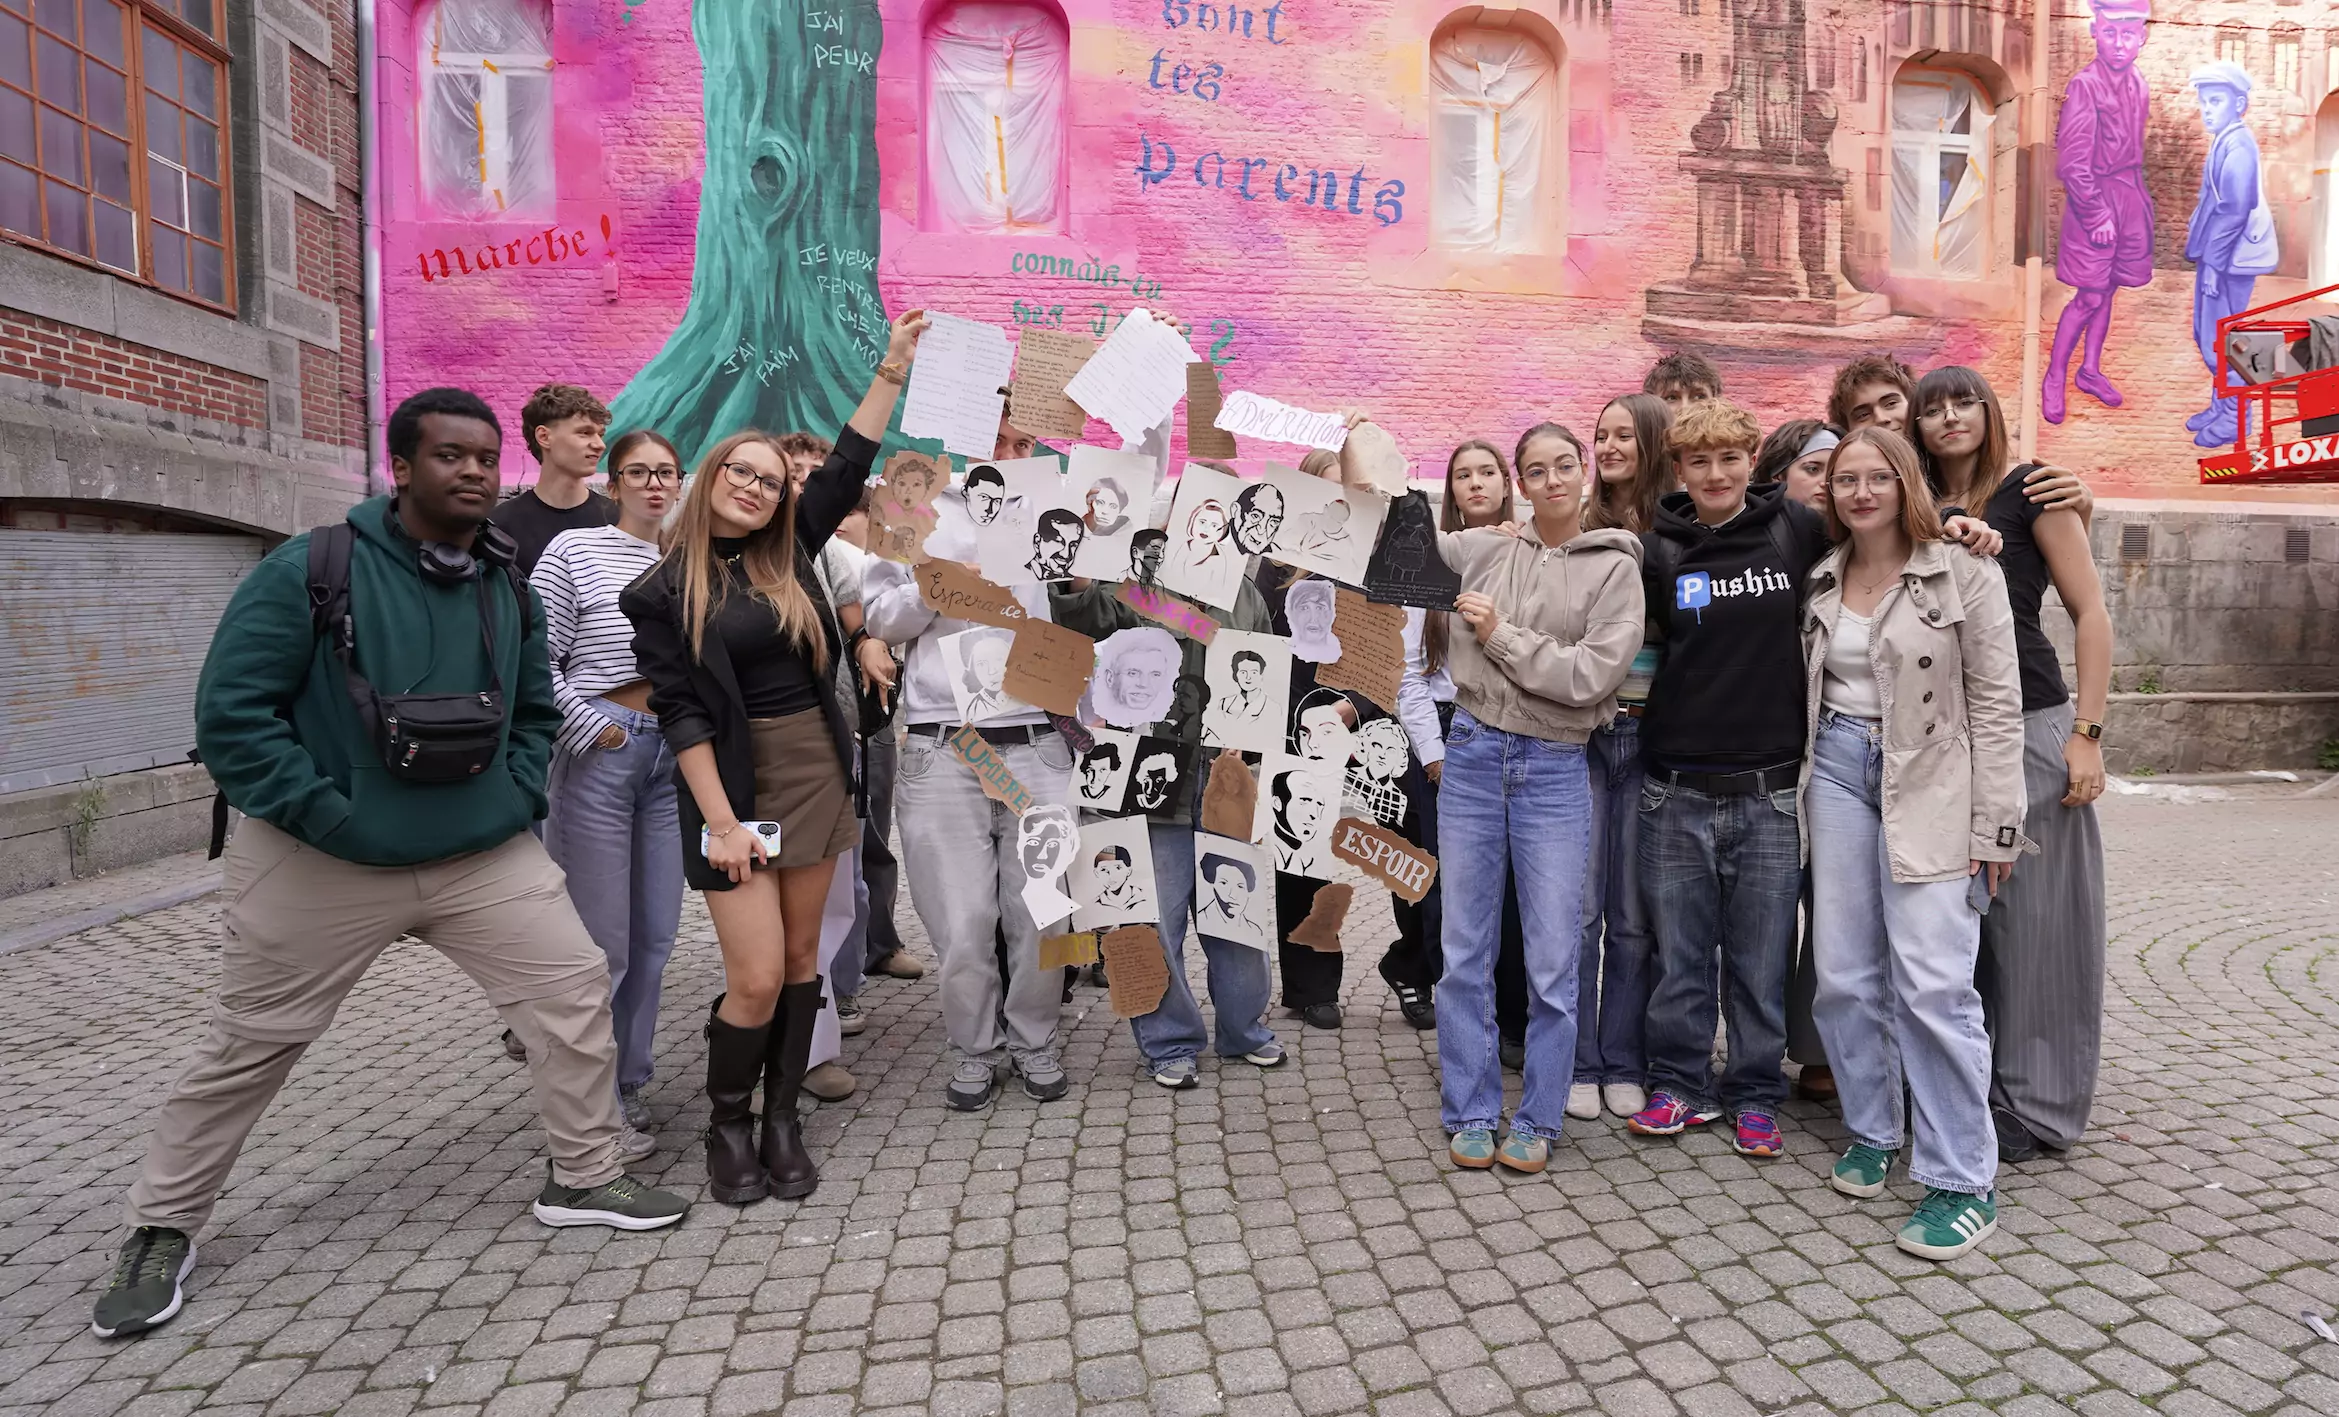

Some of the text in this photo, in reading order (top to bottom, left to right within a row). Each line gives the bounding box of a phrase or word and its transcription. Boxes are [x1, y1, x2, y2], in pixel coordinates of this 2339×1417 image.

[814, 44, 873, 75] PEUR
[1148, 48, 1224, 101] tes
[1134, 131, 1405, 227] parents
[800, 243, 876, 271] JE VEUX
[836, 304, 880, 346] CHEZ
[852, 336, 887, 369] MO
[2273, 437, 2339, 468] LOX
[1683, 566, 1792, 604] Pushin
[1338, 825, 1431, 893] ESPOIR
